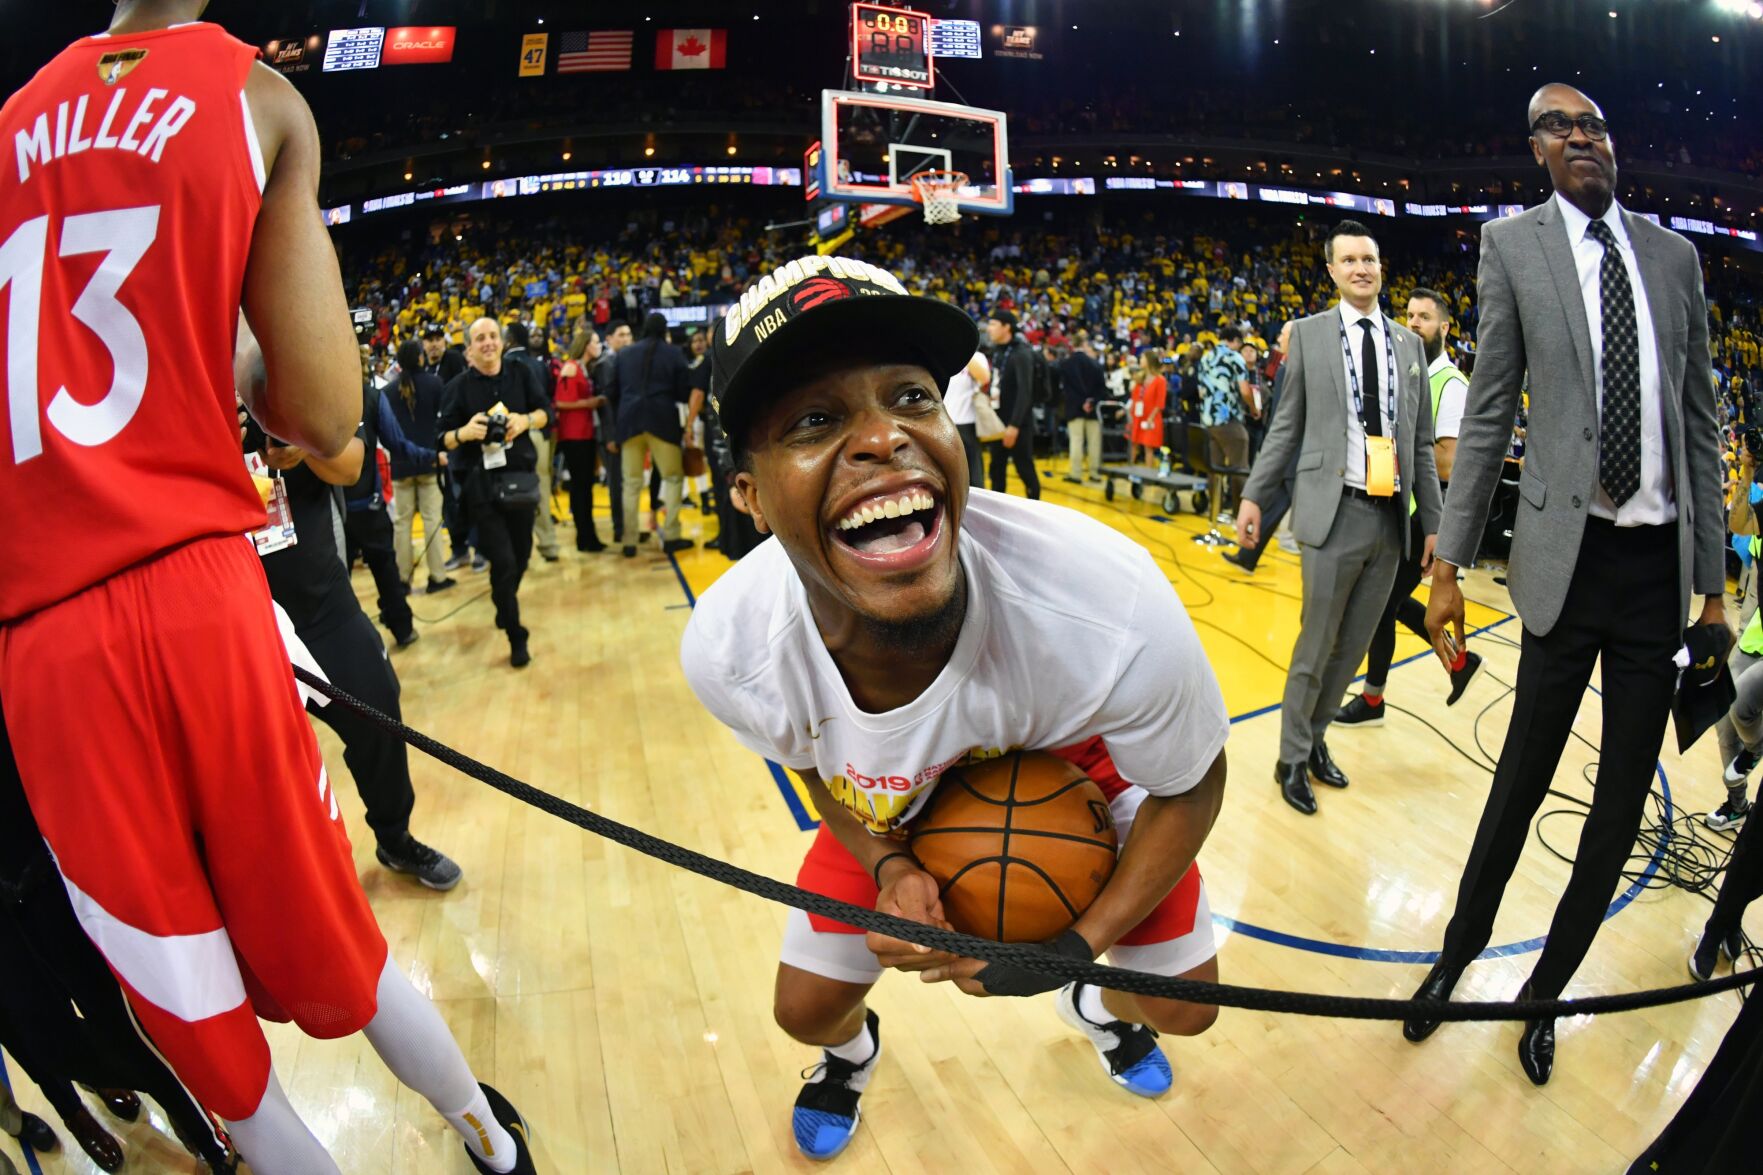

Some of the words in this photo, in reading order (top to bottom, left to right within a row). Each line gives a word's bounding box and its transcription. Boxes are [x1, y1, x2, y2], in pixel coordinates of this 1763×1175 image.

[393, 41, 445, 50] ORACLE
[525, 48, 544, 64] 47
[879, 66, 929, 81] TISSOT
[15, 87, 196, 184] MILLER
[661, 169, 690, 183] 114
[725, 255, 909, 346] CHAMPION
[0, 204, 161, 465] 13
[754, 308, 787, 343] NBA
[846, 762, 911, 792] 2019
